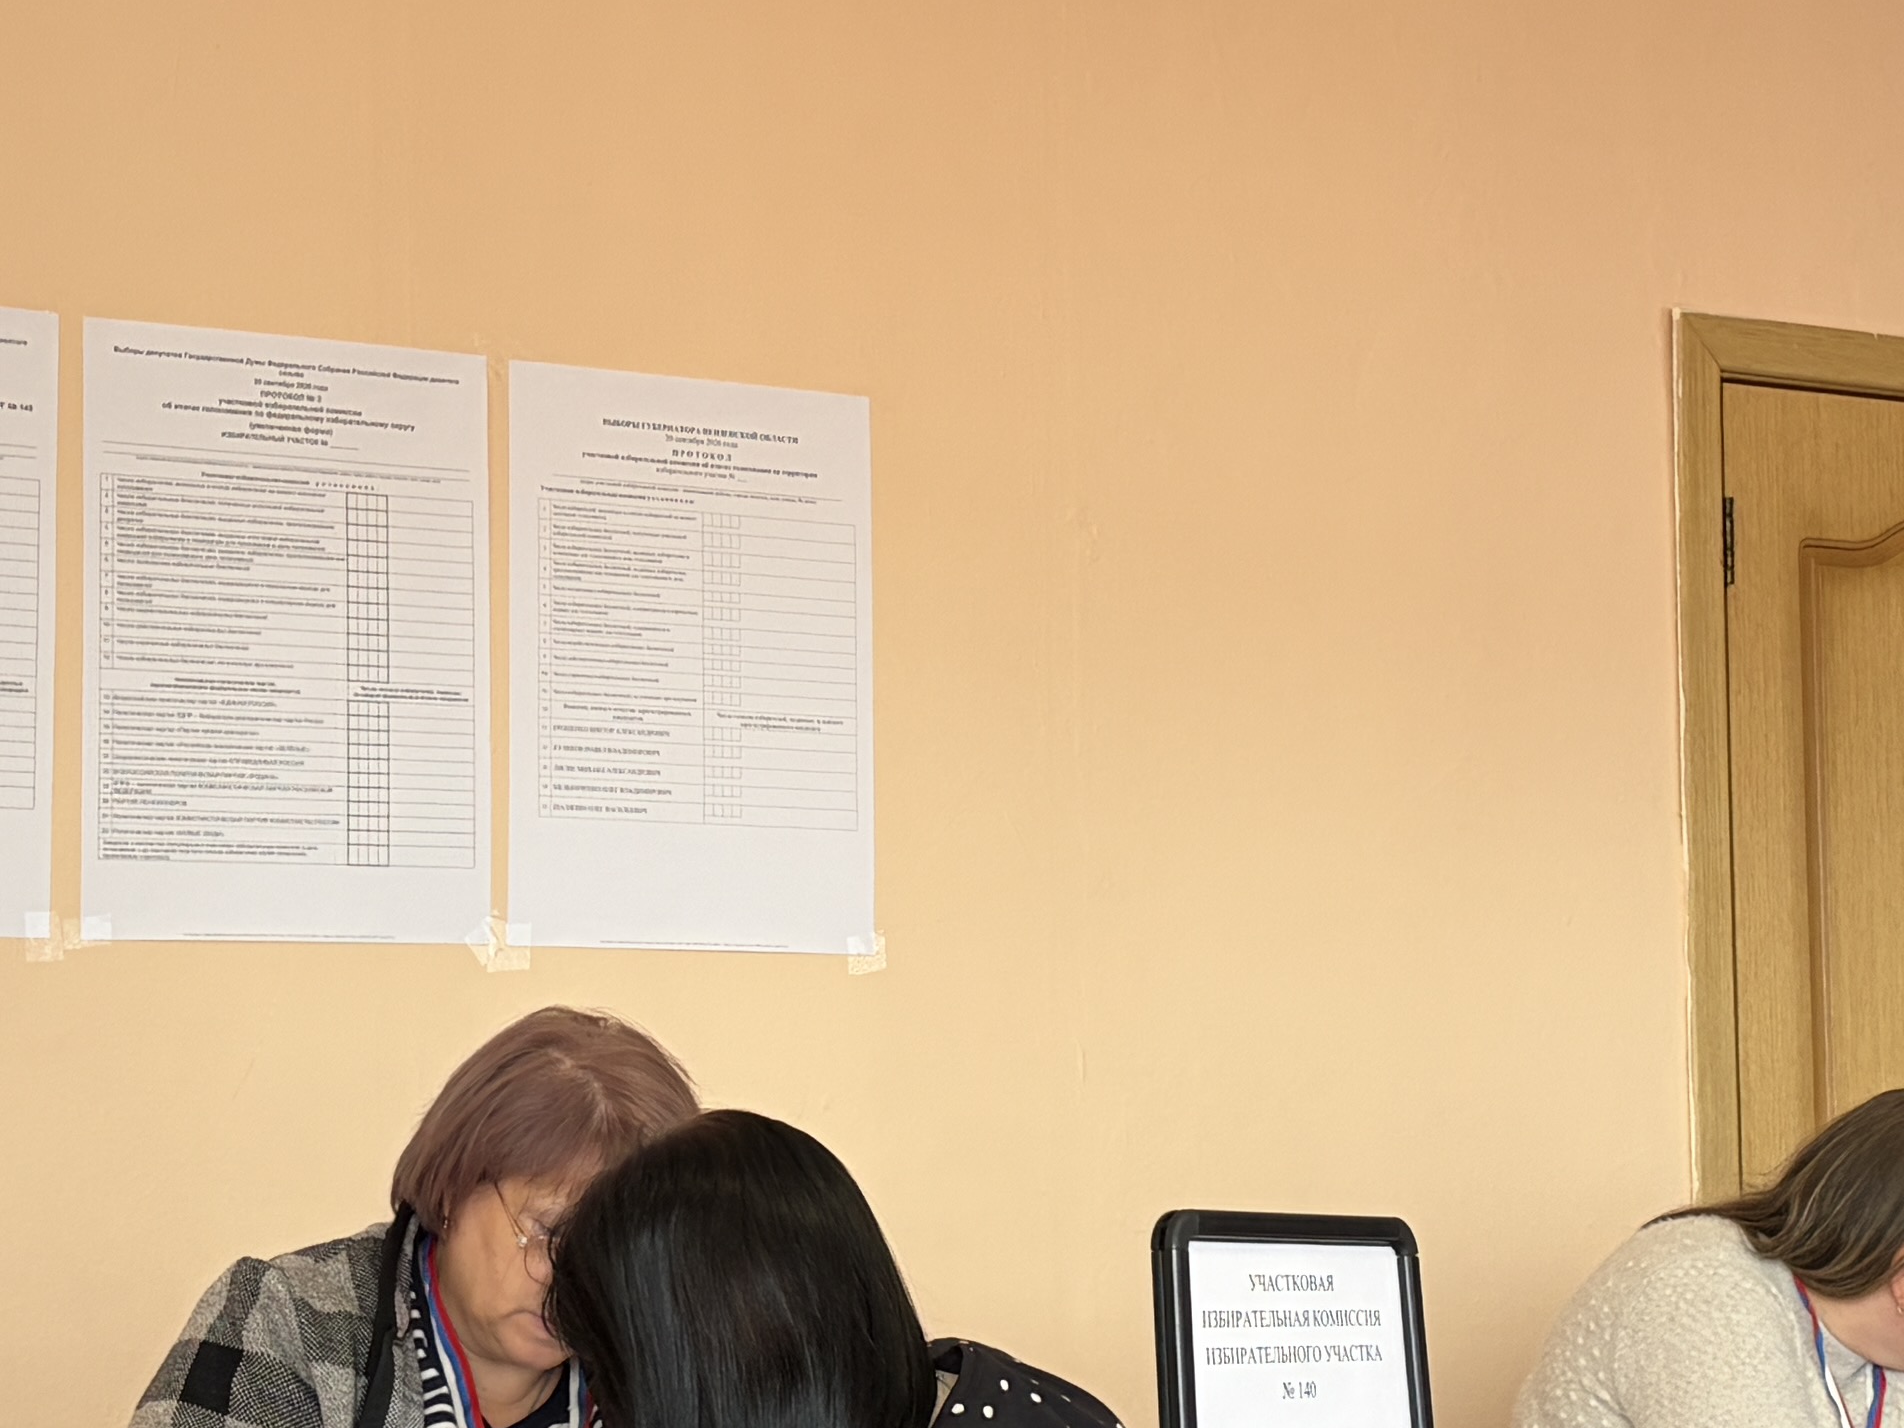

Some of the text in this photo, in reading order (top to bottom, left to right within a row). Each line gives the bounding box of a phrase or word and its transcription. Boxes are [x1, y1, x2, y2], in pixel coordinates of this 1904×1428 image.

[1248, 1274, 1335, 1293] УЧАСТКОВАЯ
[1202, 1309, 1382, 1330] ИЗБИРАТЕЛЬНАЯ КОМИССИЯ
[1206, 1344, 1383, 1366] ИЗБИРАТЕЛЬНОГО УЧАСТКА
[1298, 1381, 1317, 1399] 140
